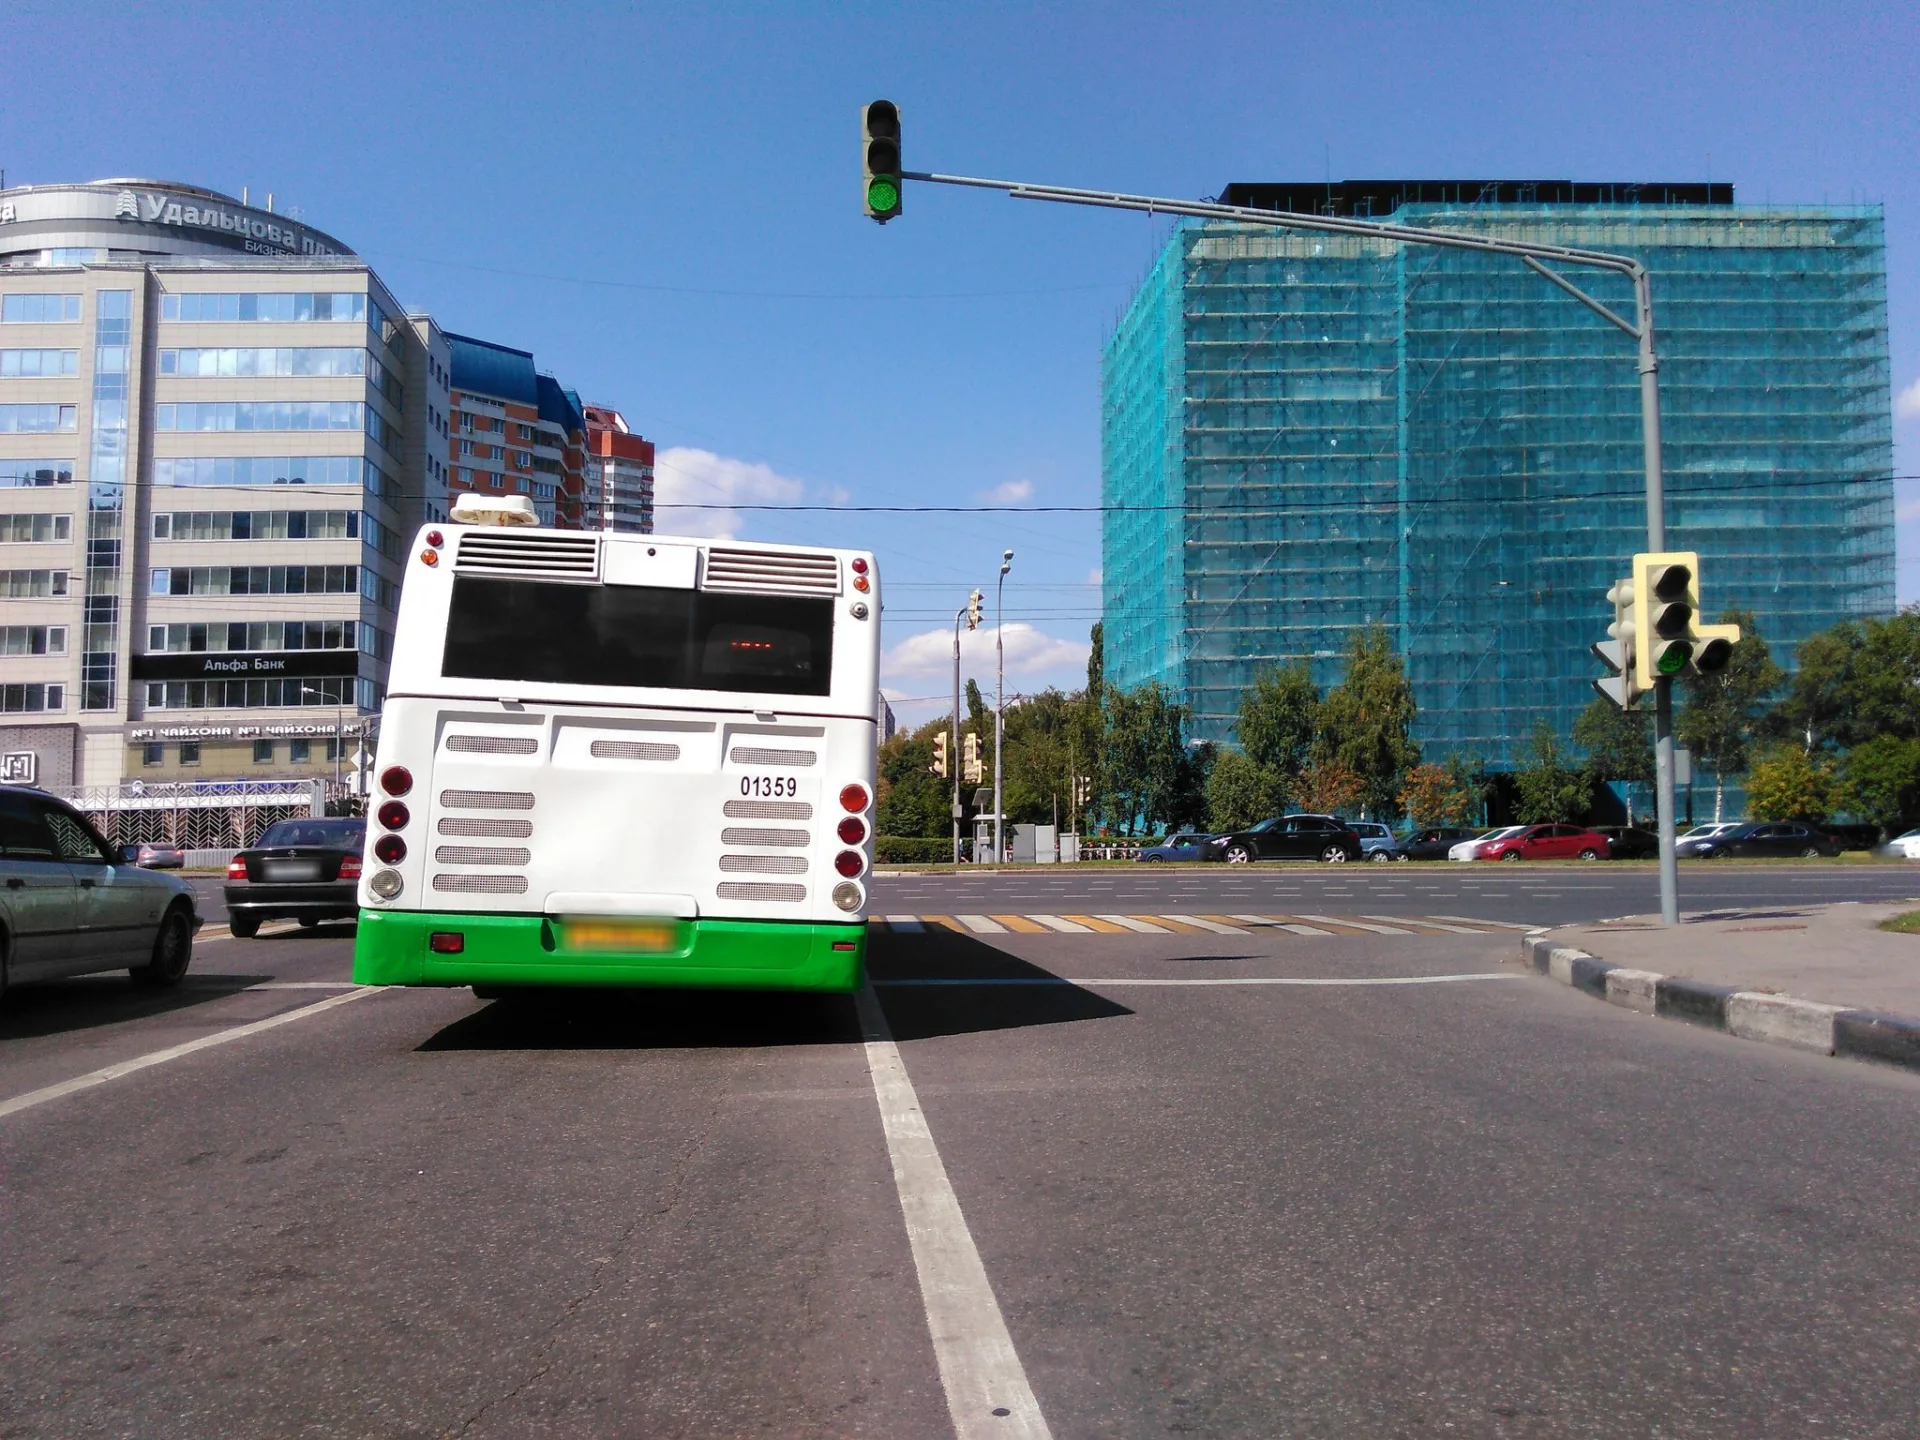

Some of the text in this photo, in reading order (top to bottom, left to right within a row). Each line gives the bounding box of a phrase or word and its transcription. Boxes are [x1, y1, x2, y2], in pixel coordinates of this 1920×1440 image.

[147, 194, 296, 249] Удальцова
[204, 658, 285, 672] Альфа Банк
[160, 726, 231, 736] ЧАЙХОНА
[266, 723, 335, 734] ЧАЙХОНА
[741, 776, 797, 797] 01359
